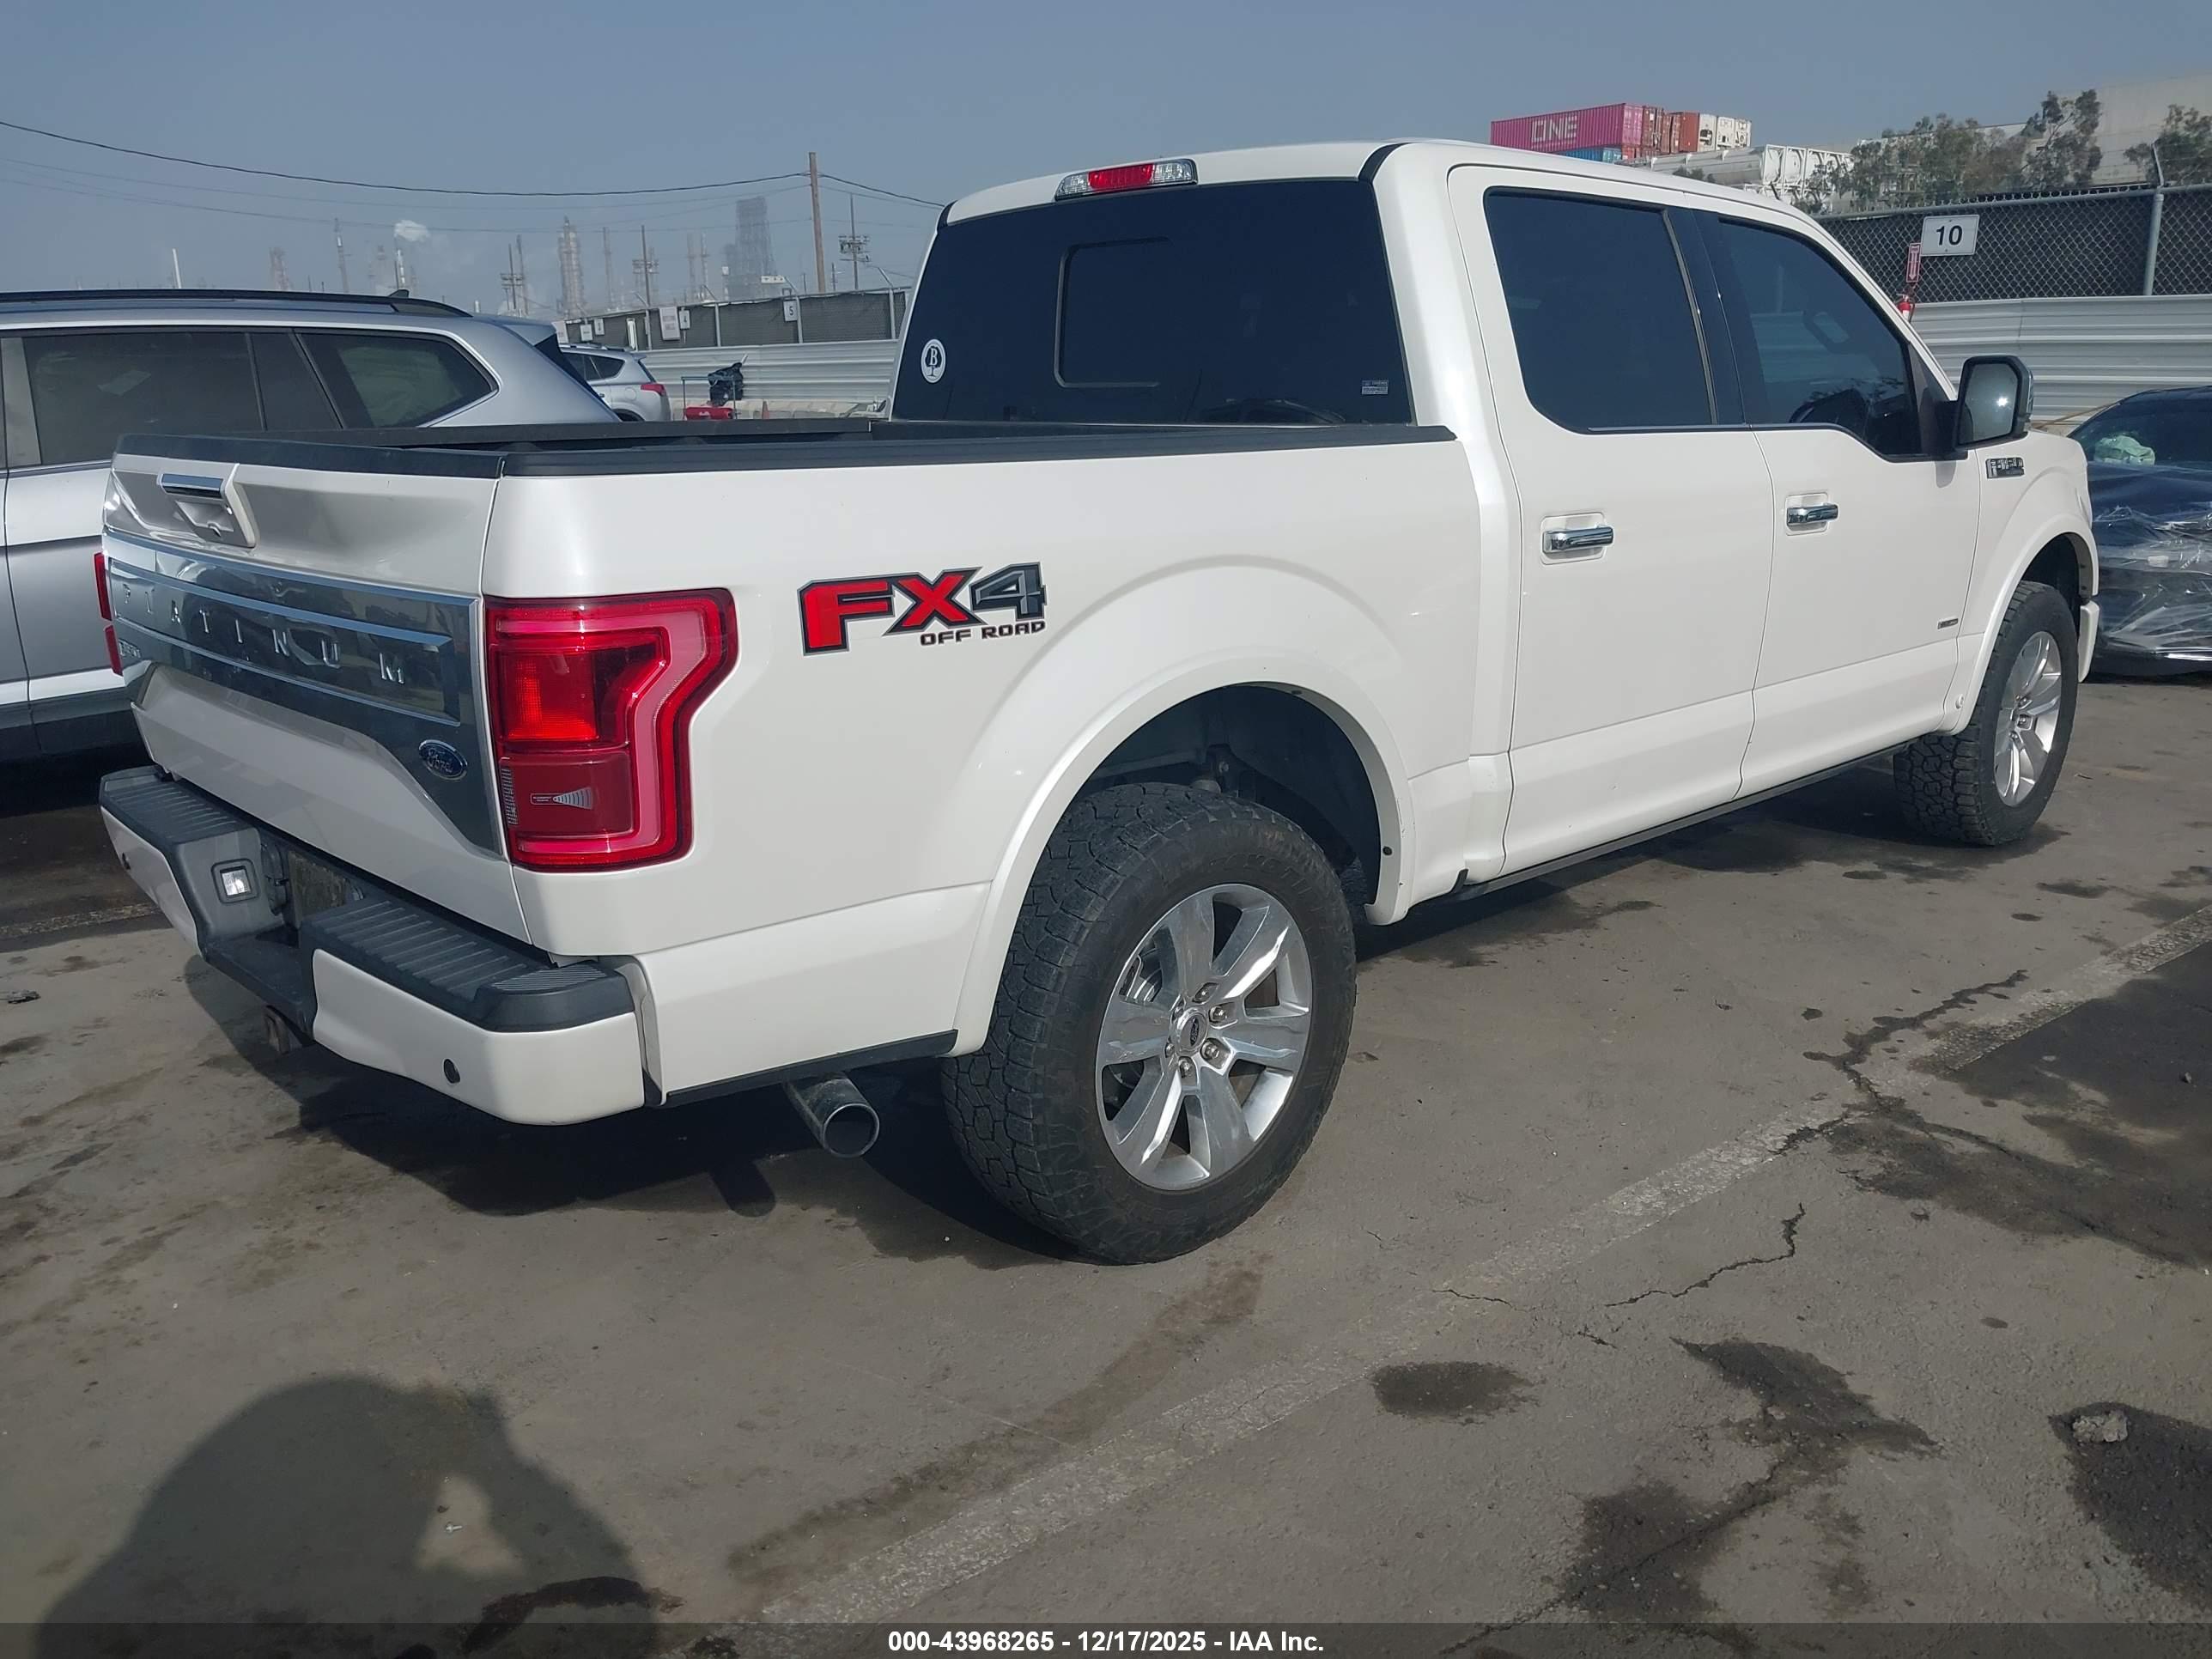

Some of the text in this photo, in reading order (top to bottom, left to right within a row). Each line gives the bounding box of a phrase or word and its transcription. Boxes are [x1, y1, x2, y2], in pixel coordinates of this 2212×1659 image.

[1531, 115, 1577, 143] ONE
[1936, 225, 1963, 246] 10
[797, 562, 1048, 656] FX4
[122, 581, 405, 684] PLATINUM
[920, 620, 1047, 647] OFF ROAD
